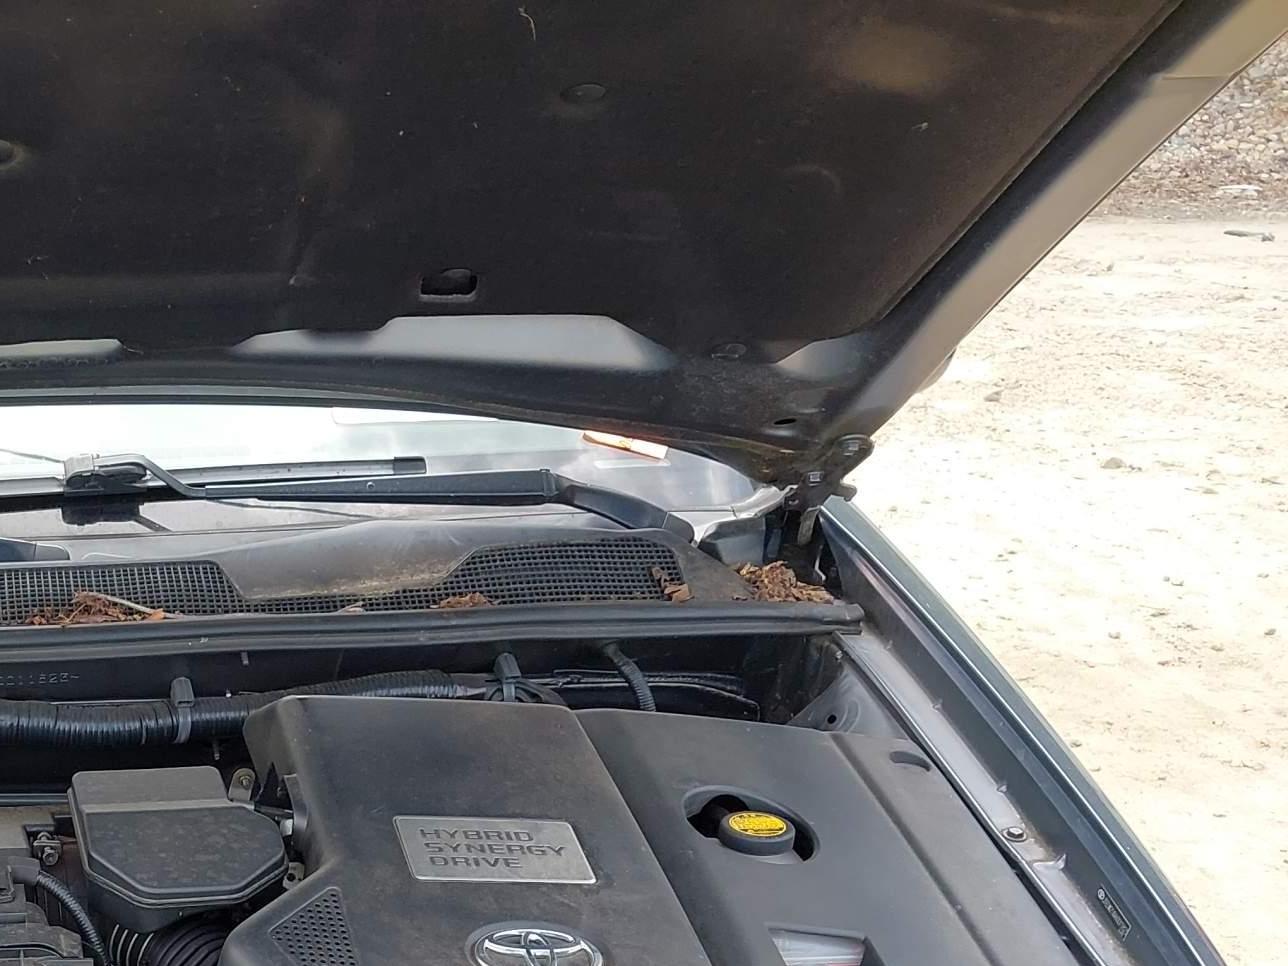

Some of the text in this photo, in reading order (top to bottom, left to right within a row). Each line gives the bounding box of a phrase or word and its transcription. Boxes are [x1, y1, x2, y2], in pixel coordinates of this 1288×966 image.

[419, 829, 534, 842] HYBRID
[424, 842, 565, 857] SYNERGY
[429, 856, 524, 869] DRIVE
